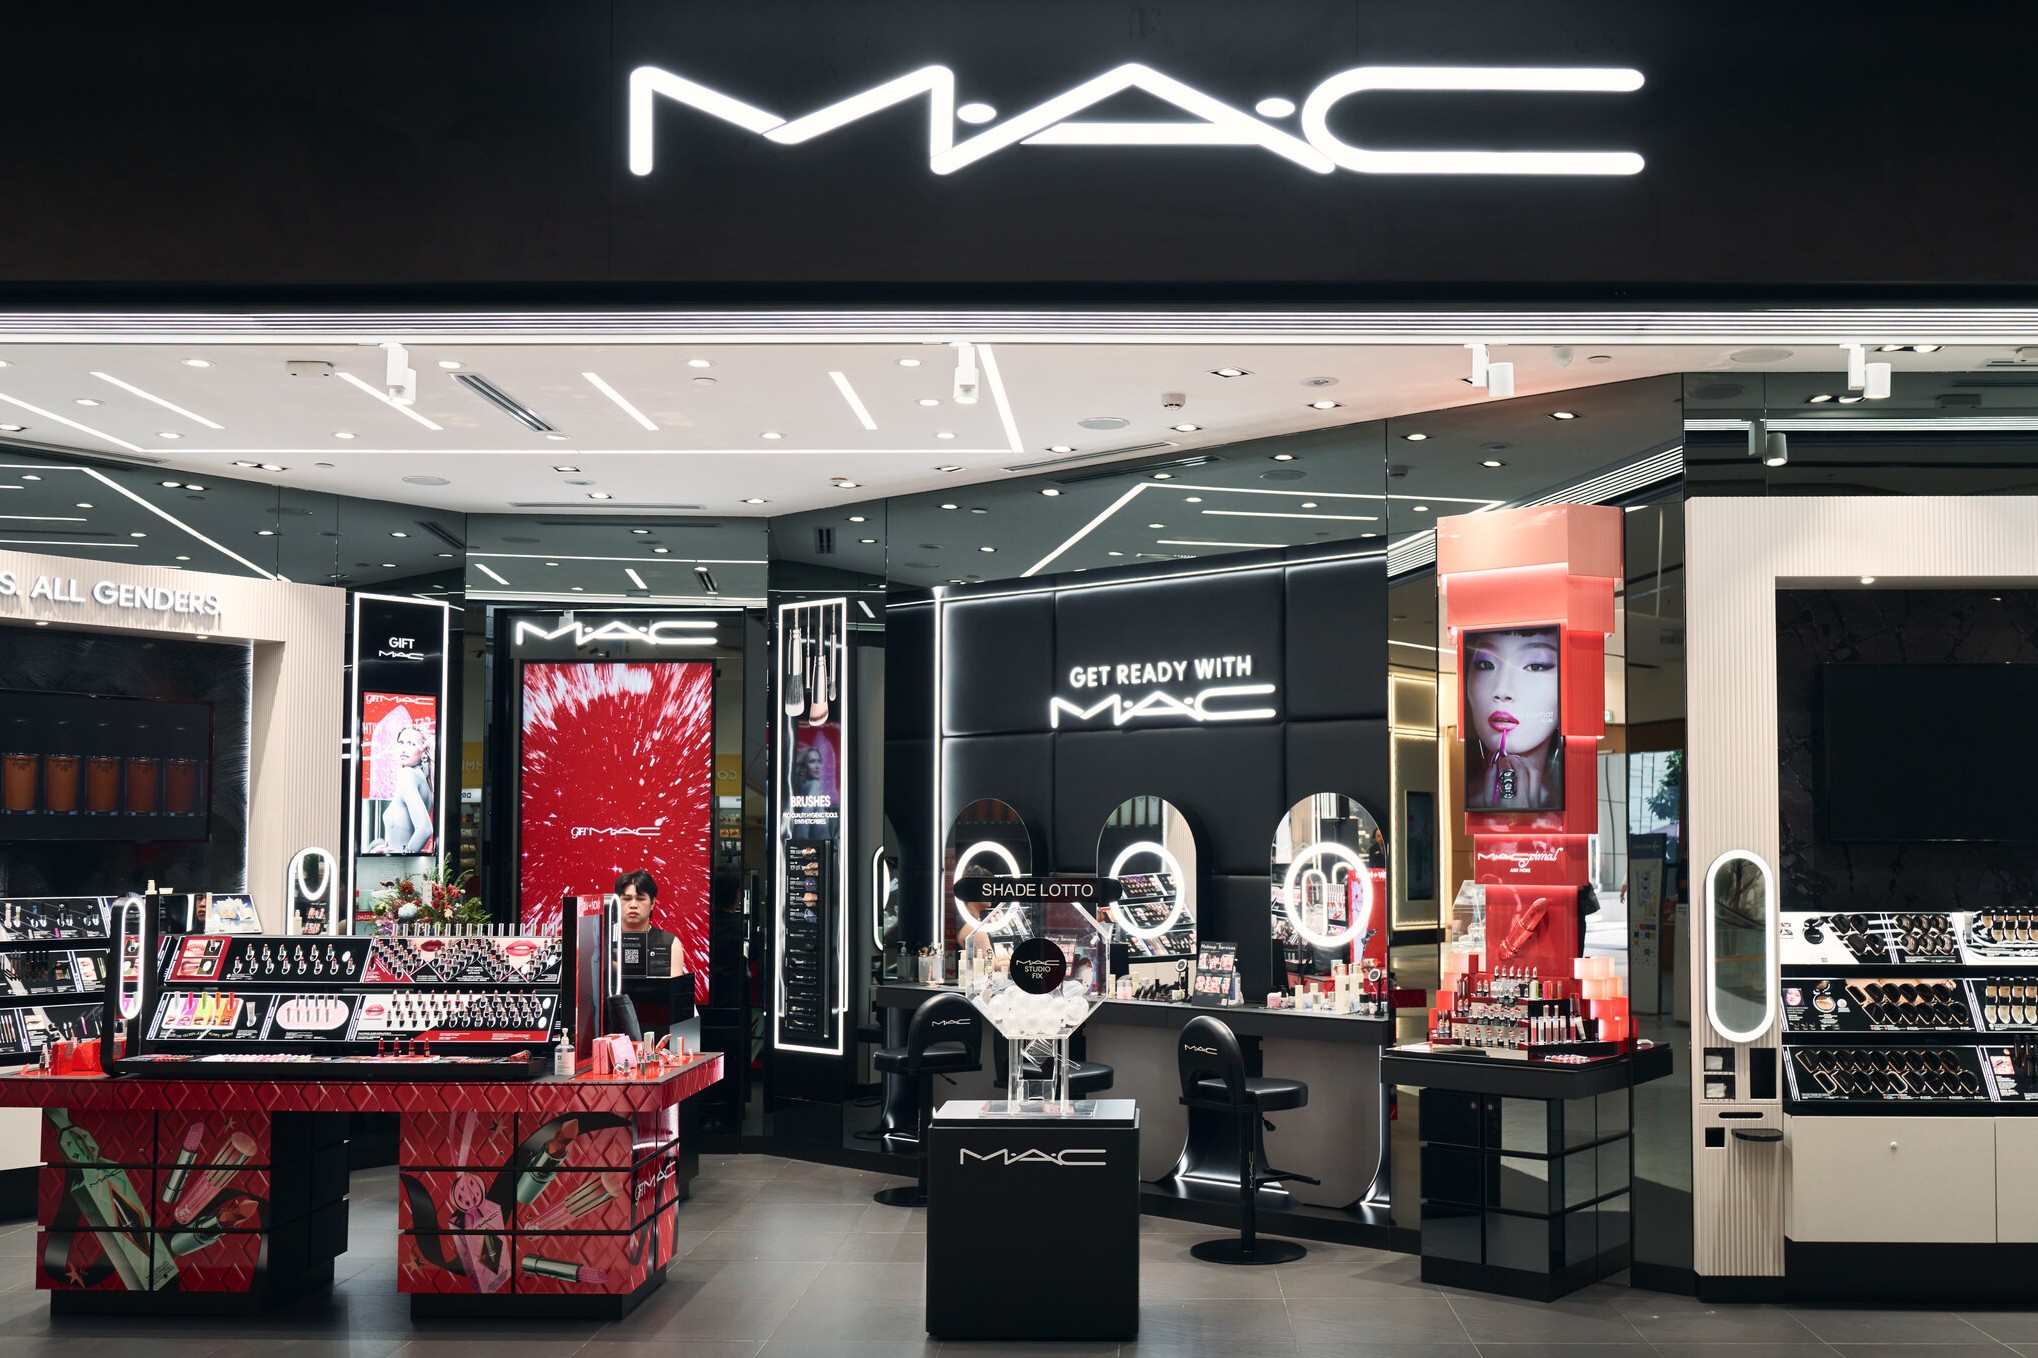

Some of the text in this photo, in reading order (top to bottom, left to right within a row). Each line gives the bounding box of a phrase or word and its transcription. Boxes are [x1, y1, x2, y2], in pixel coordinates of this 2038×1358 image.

[30, 574, 86, 603] ALL
[388, 636, 416, 650] GIFT
[1069, 655, 1252, 689] GET READY WITH
[791, 795, 831, 807] BRUSHES
[981, 882, 1094, 897] SHADE LOTTO
